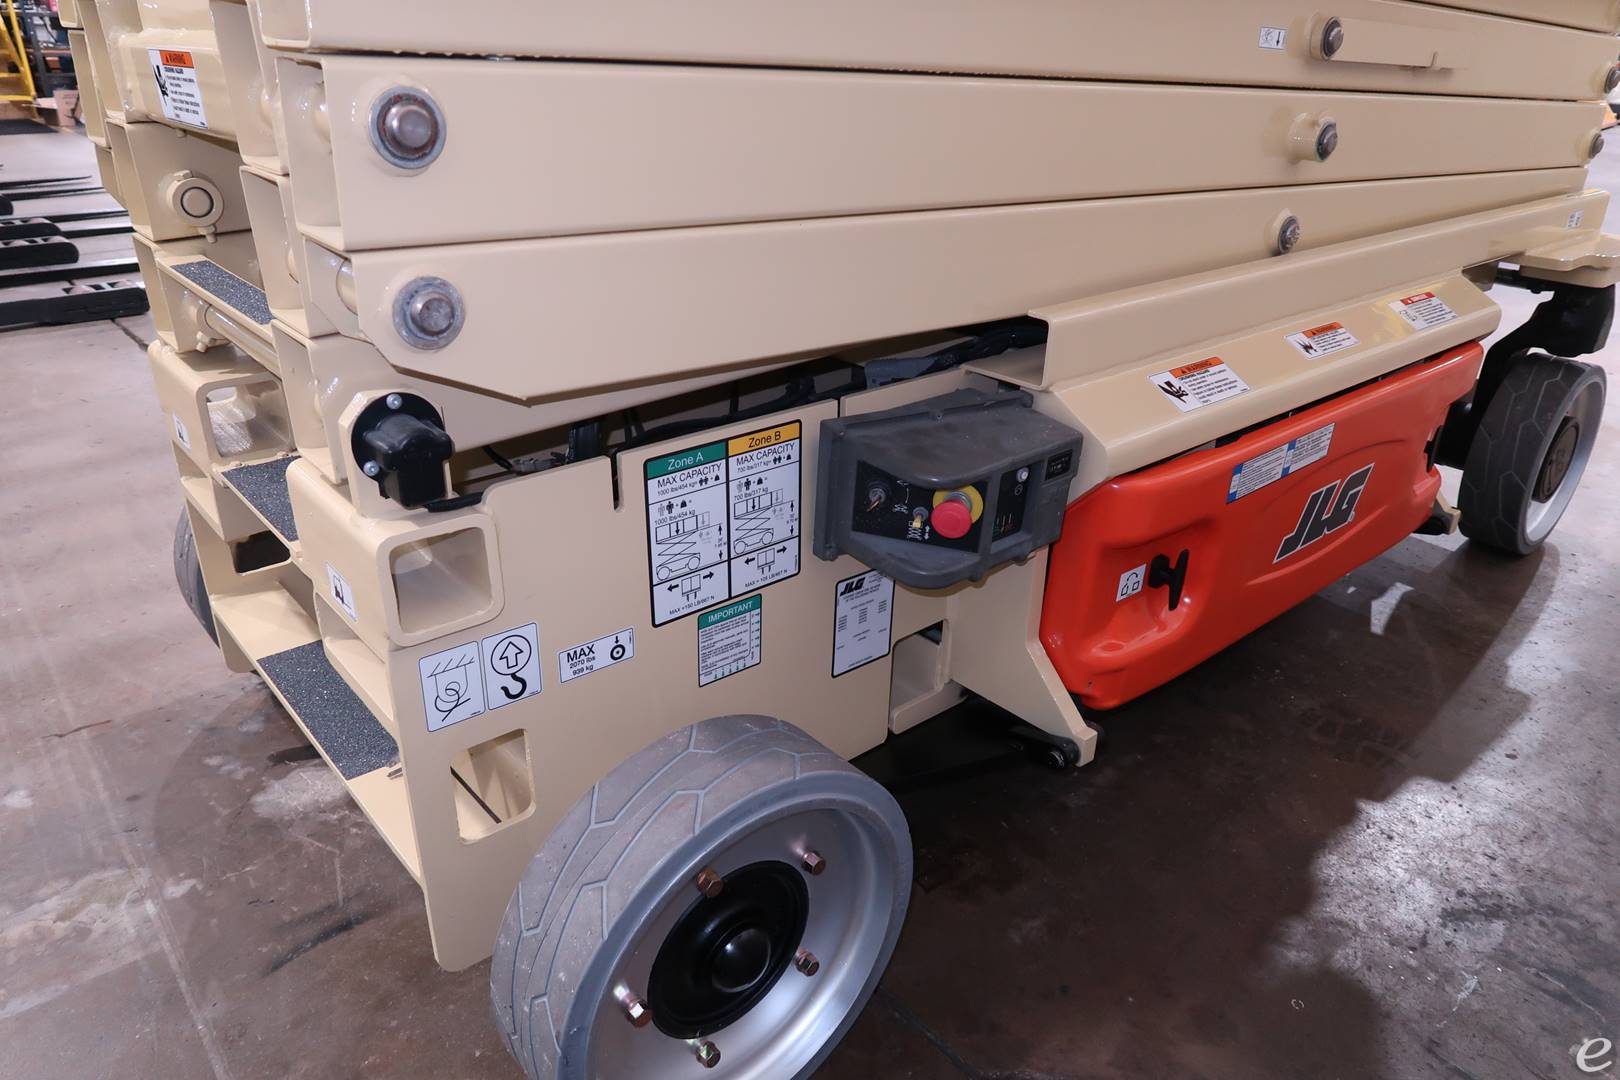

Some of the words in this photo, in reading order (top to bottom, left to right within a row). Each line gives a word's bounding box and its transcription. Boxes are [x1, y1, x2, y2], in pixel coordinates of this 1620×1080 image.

[748, 435, 772, 448] Zone
[774, 431, 781, 441] B
[667, 456, 694, 470] Zone
[695, 452, 704, 463] A
[736, 453, 754, 466] MAX
[756, 442, 795, 460] CAPACITY
[657, 474, 677, 489] MAX
[679, 463, 722, 482] CAPACITY
[1272, 462, 1375, 564] JLG
[839, 577, 866, 597] JLG
[708, 601, 753, 623] IMPORTANT
[566, 643, 596, 663] MAX
[569, 659, 585, 669] 2070
